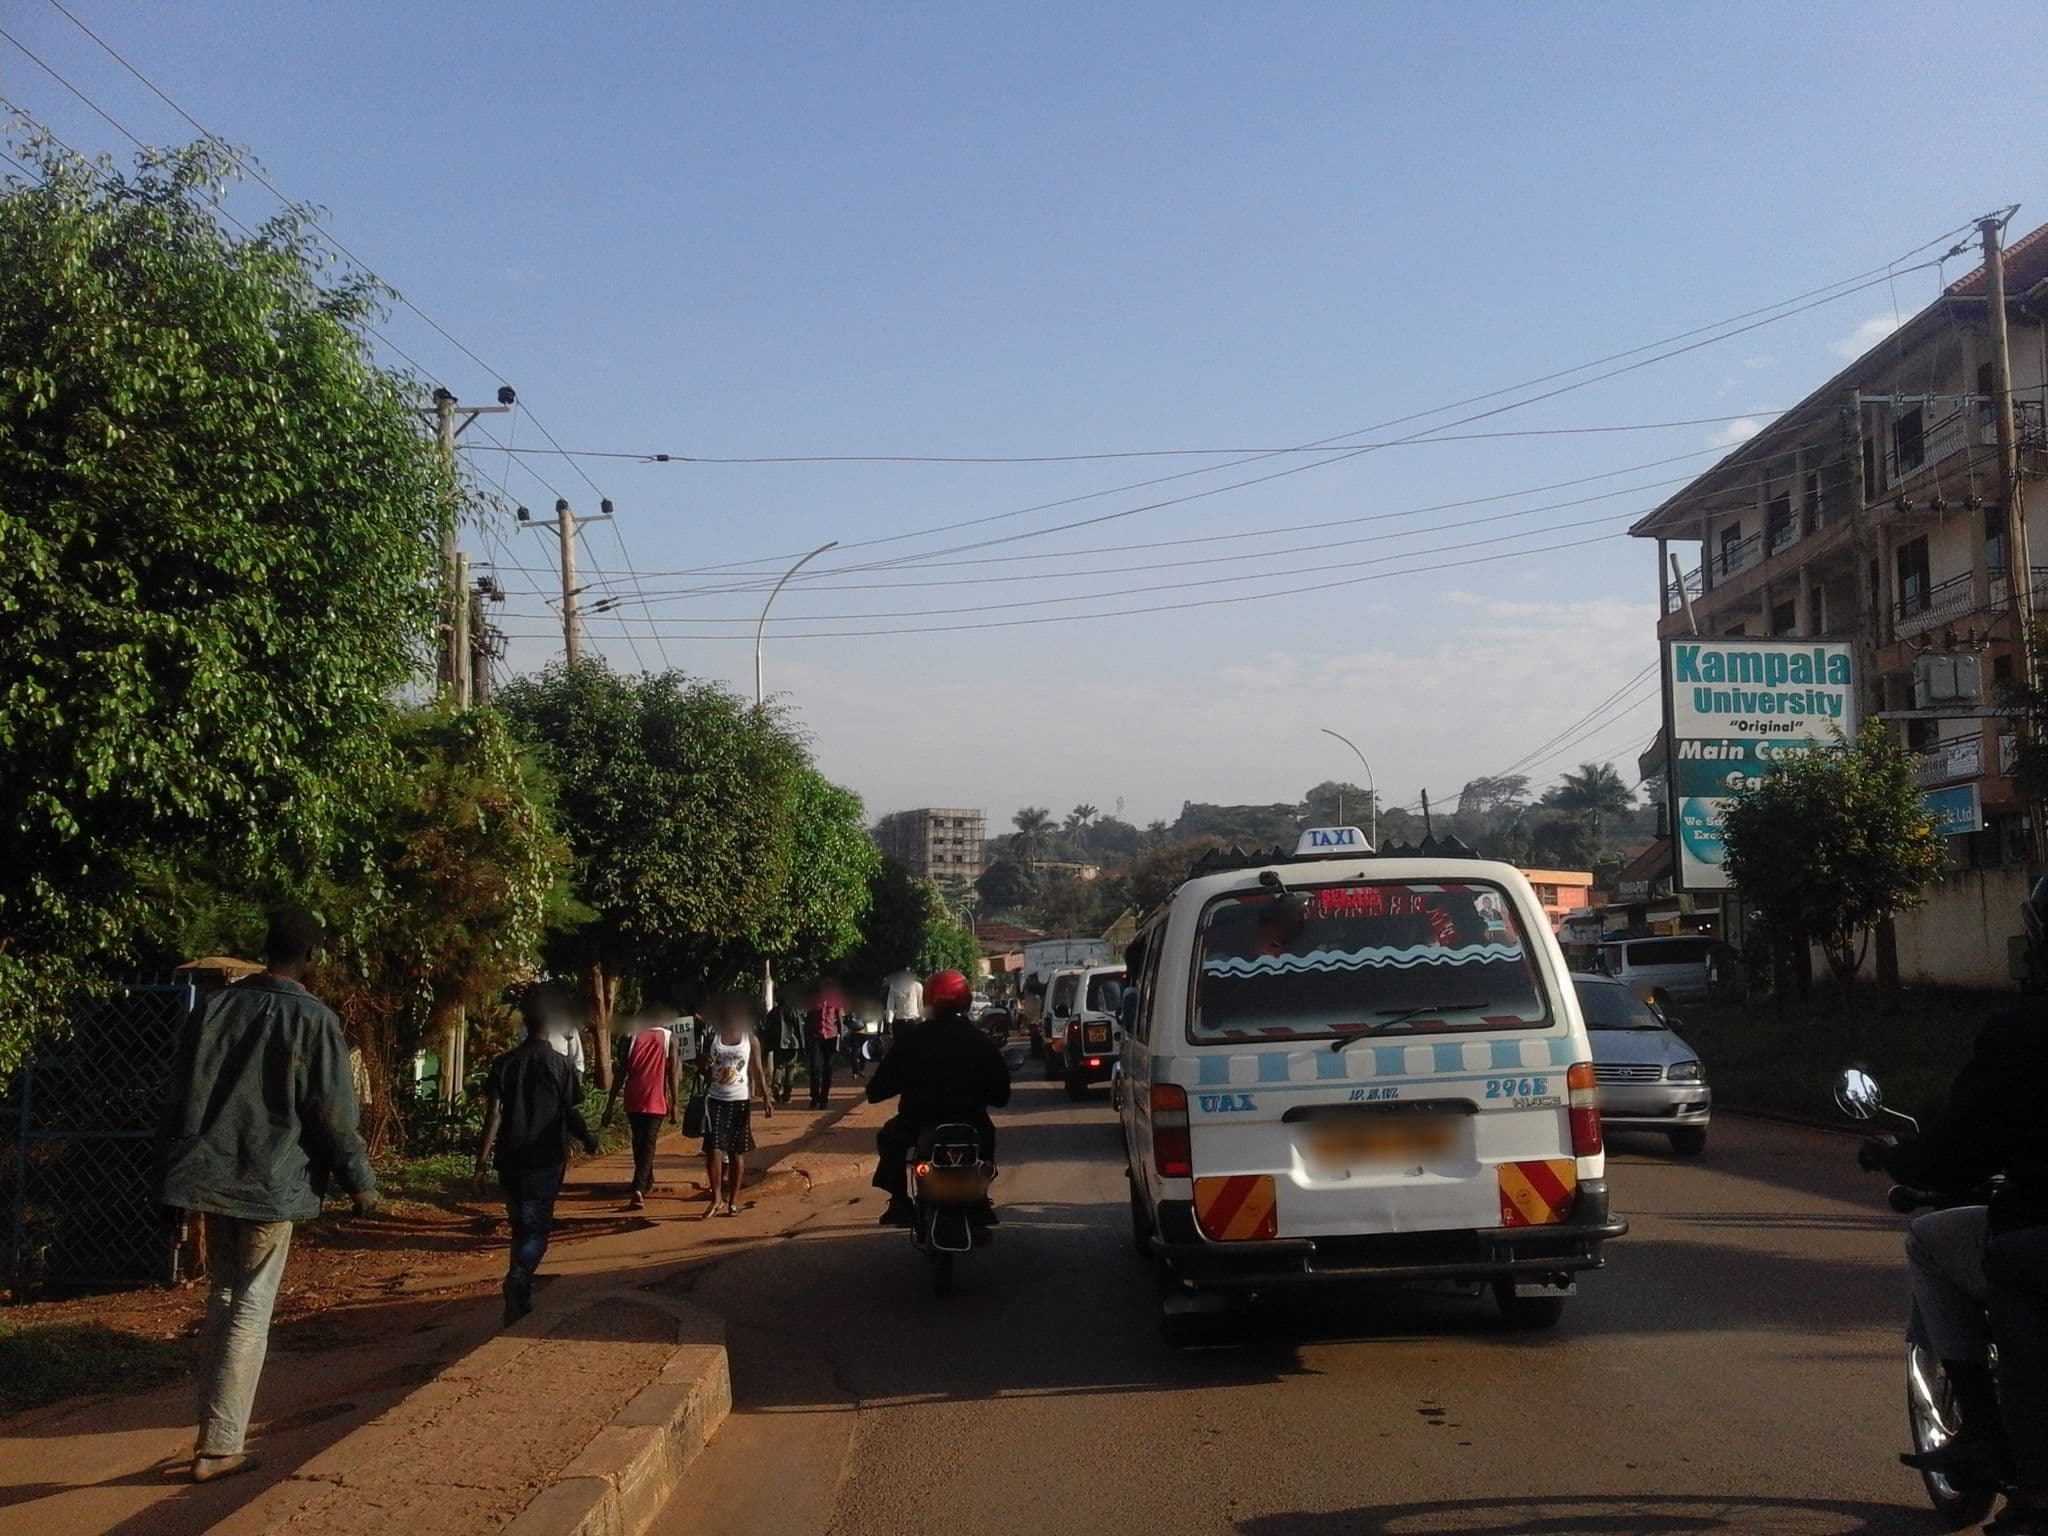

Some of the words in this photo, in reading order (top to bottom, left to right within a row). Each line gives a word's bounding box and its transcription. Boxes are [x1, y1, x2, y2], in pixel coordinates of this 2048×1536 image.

[1675, 645, 1851, 687] Kampala
[1693, 687, 1843, 717] University
[1678, 740, 1744, 760] Main
[1684, 816, 1703, 826] We
[1307, 829, 1355, 848] TAXI
[1199, 1094, 1257, 1113] UAX
